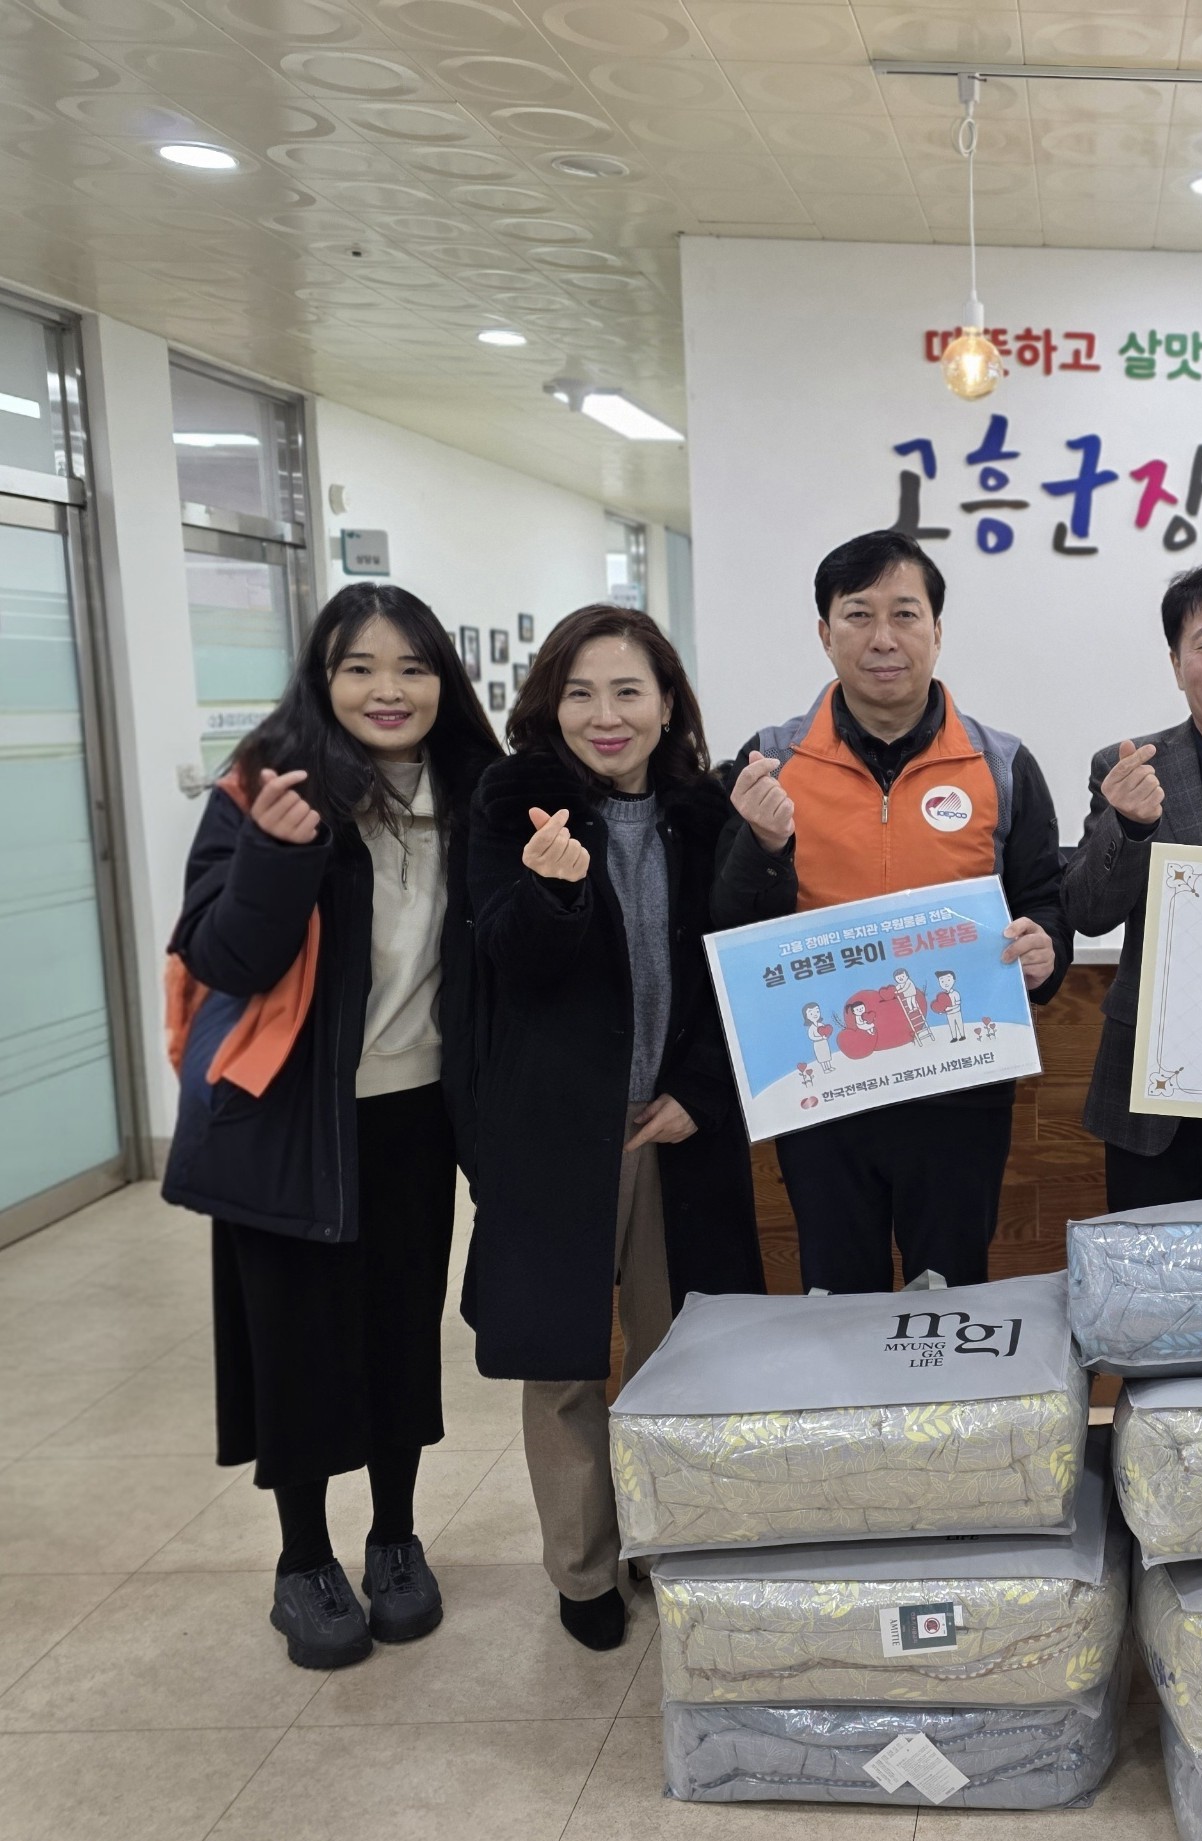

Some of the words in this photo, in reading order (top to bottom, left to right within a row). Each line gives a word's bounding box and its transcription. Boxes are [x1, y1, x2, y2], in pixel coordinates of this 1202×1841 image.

[778, 940, 804, 957] 고흥
[805, 931, 842, 950] 장애인
[842, 923, 879, 941] 복지관
[880, 912, 928, 934] 후원물품
[928, 906, 953, 924] 전달
[762, 963, 787, 989] 설
[790, 951, 837, 981] 명절
[840, 940, 887, 969] 맞이
[891, 920, 979, 958] 봉사활동
[821, 1075, 890, 1103] 한국전력공사
[891, 1064, 937, 1085] 고흥지사
[939, 1051, 995, 1074] 사회봉사단
[884, 1341, 946, 1352] MYUNG
[921, 1349, 945, 1358] GA
[909, 1358, 944, 1368] LIFE
[889, 1619, 900, 1647] AMITIE
